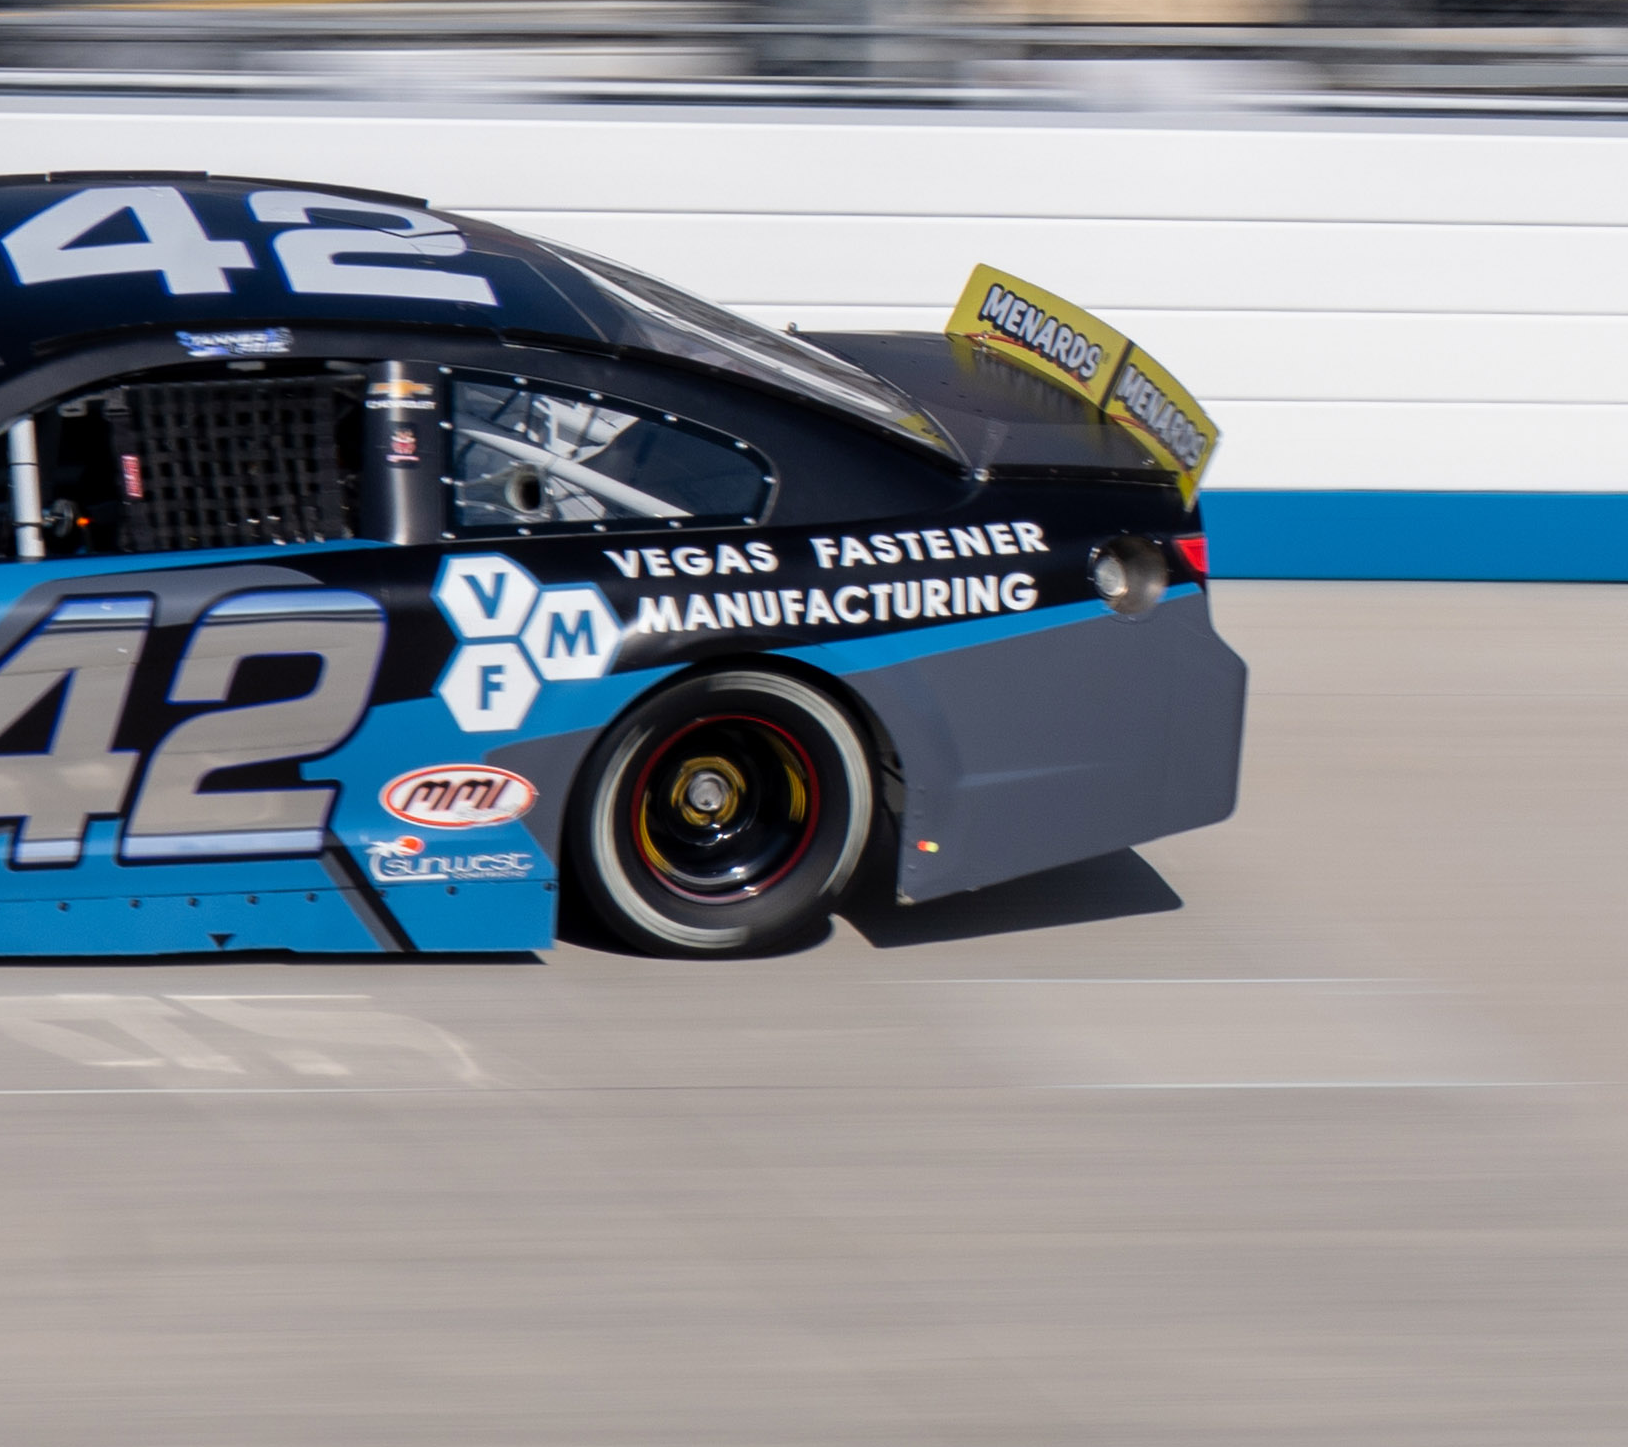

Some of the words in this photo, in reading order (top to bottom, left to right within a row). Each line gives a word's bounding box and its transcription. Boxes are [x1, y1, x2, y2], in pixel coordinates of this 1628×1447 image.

[0, 186, 500, 306] 42
[979, 284, 1102, 381] MENARDS
[1115, 363, 1208, 469] MENARDS
[604, 542, 779, 578] VEGAS
[810, 521, 1049, 568] FASTENER
[461, 573, 512, 620] V
[637, 573, 1039, 634] MANUFACTURING
[546, 611, 599, 659] M
[479, 666, 504, 712] F
